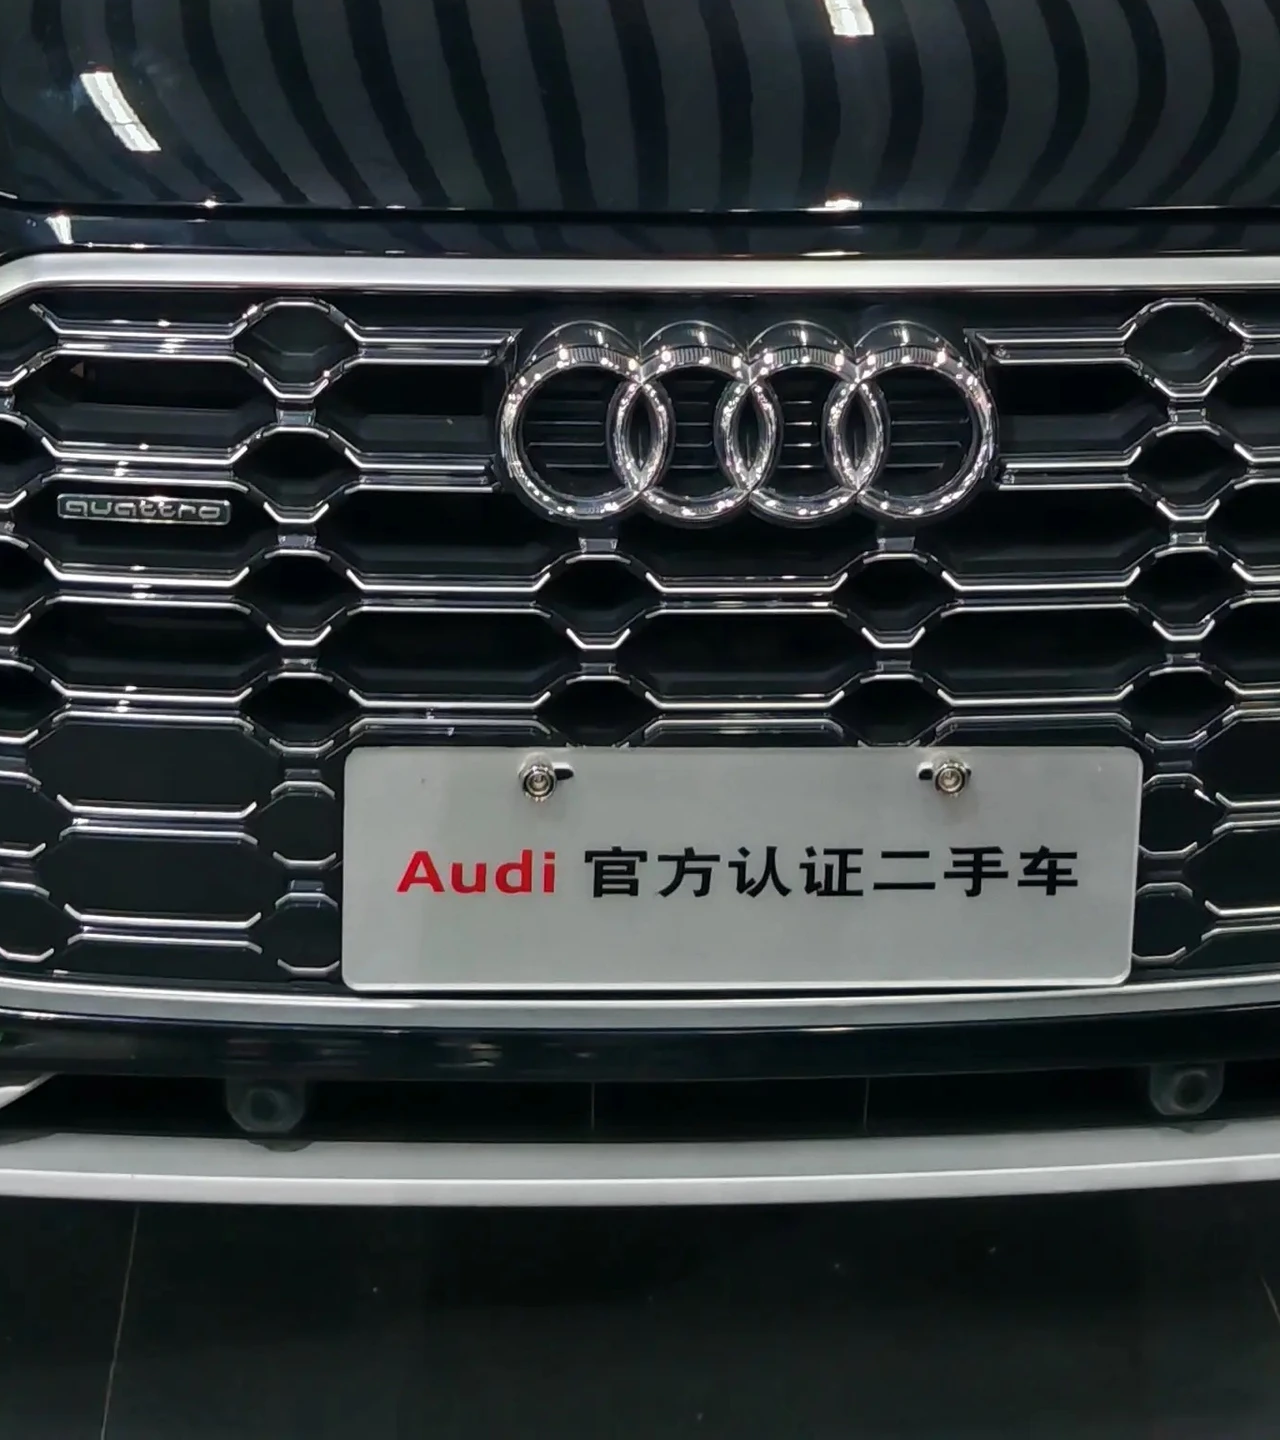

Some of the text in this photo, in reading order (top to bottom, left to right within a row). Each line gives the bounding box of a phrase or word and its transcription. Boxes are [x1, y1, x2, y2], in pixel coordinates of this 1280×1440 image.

[65, 500, 221, 520] quattro
[397, 845, 1079, 898] Audi 官方认证二手车
